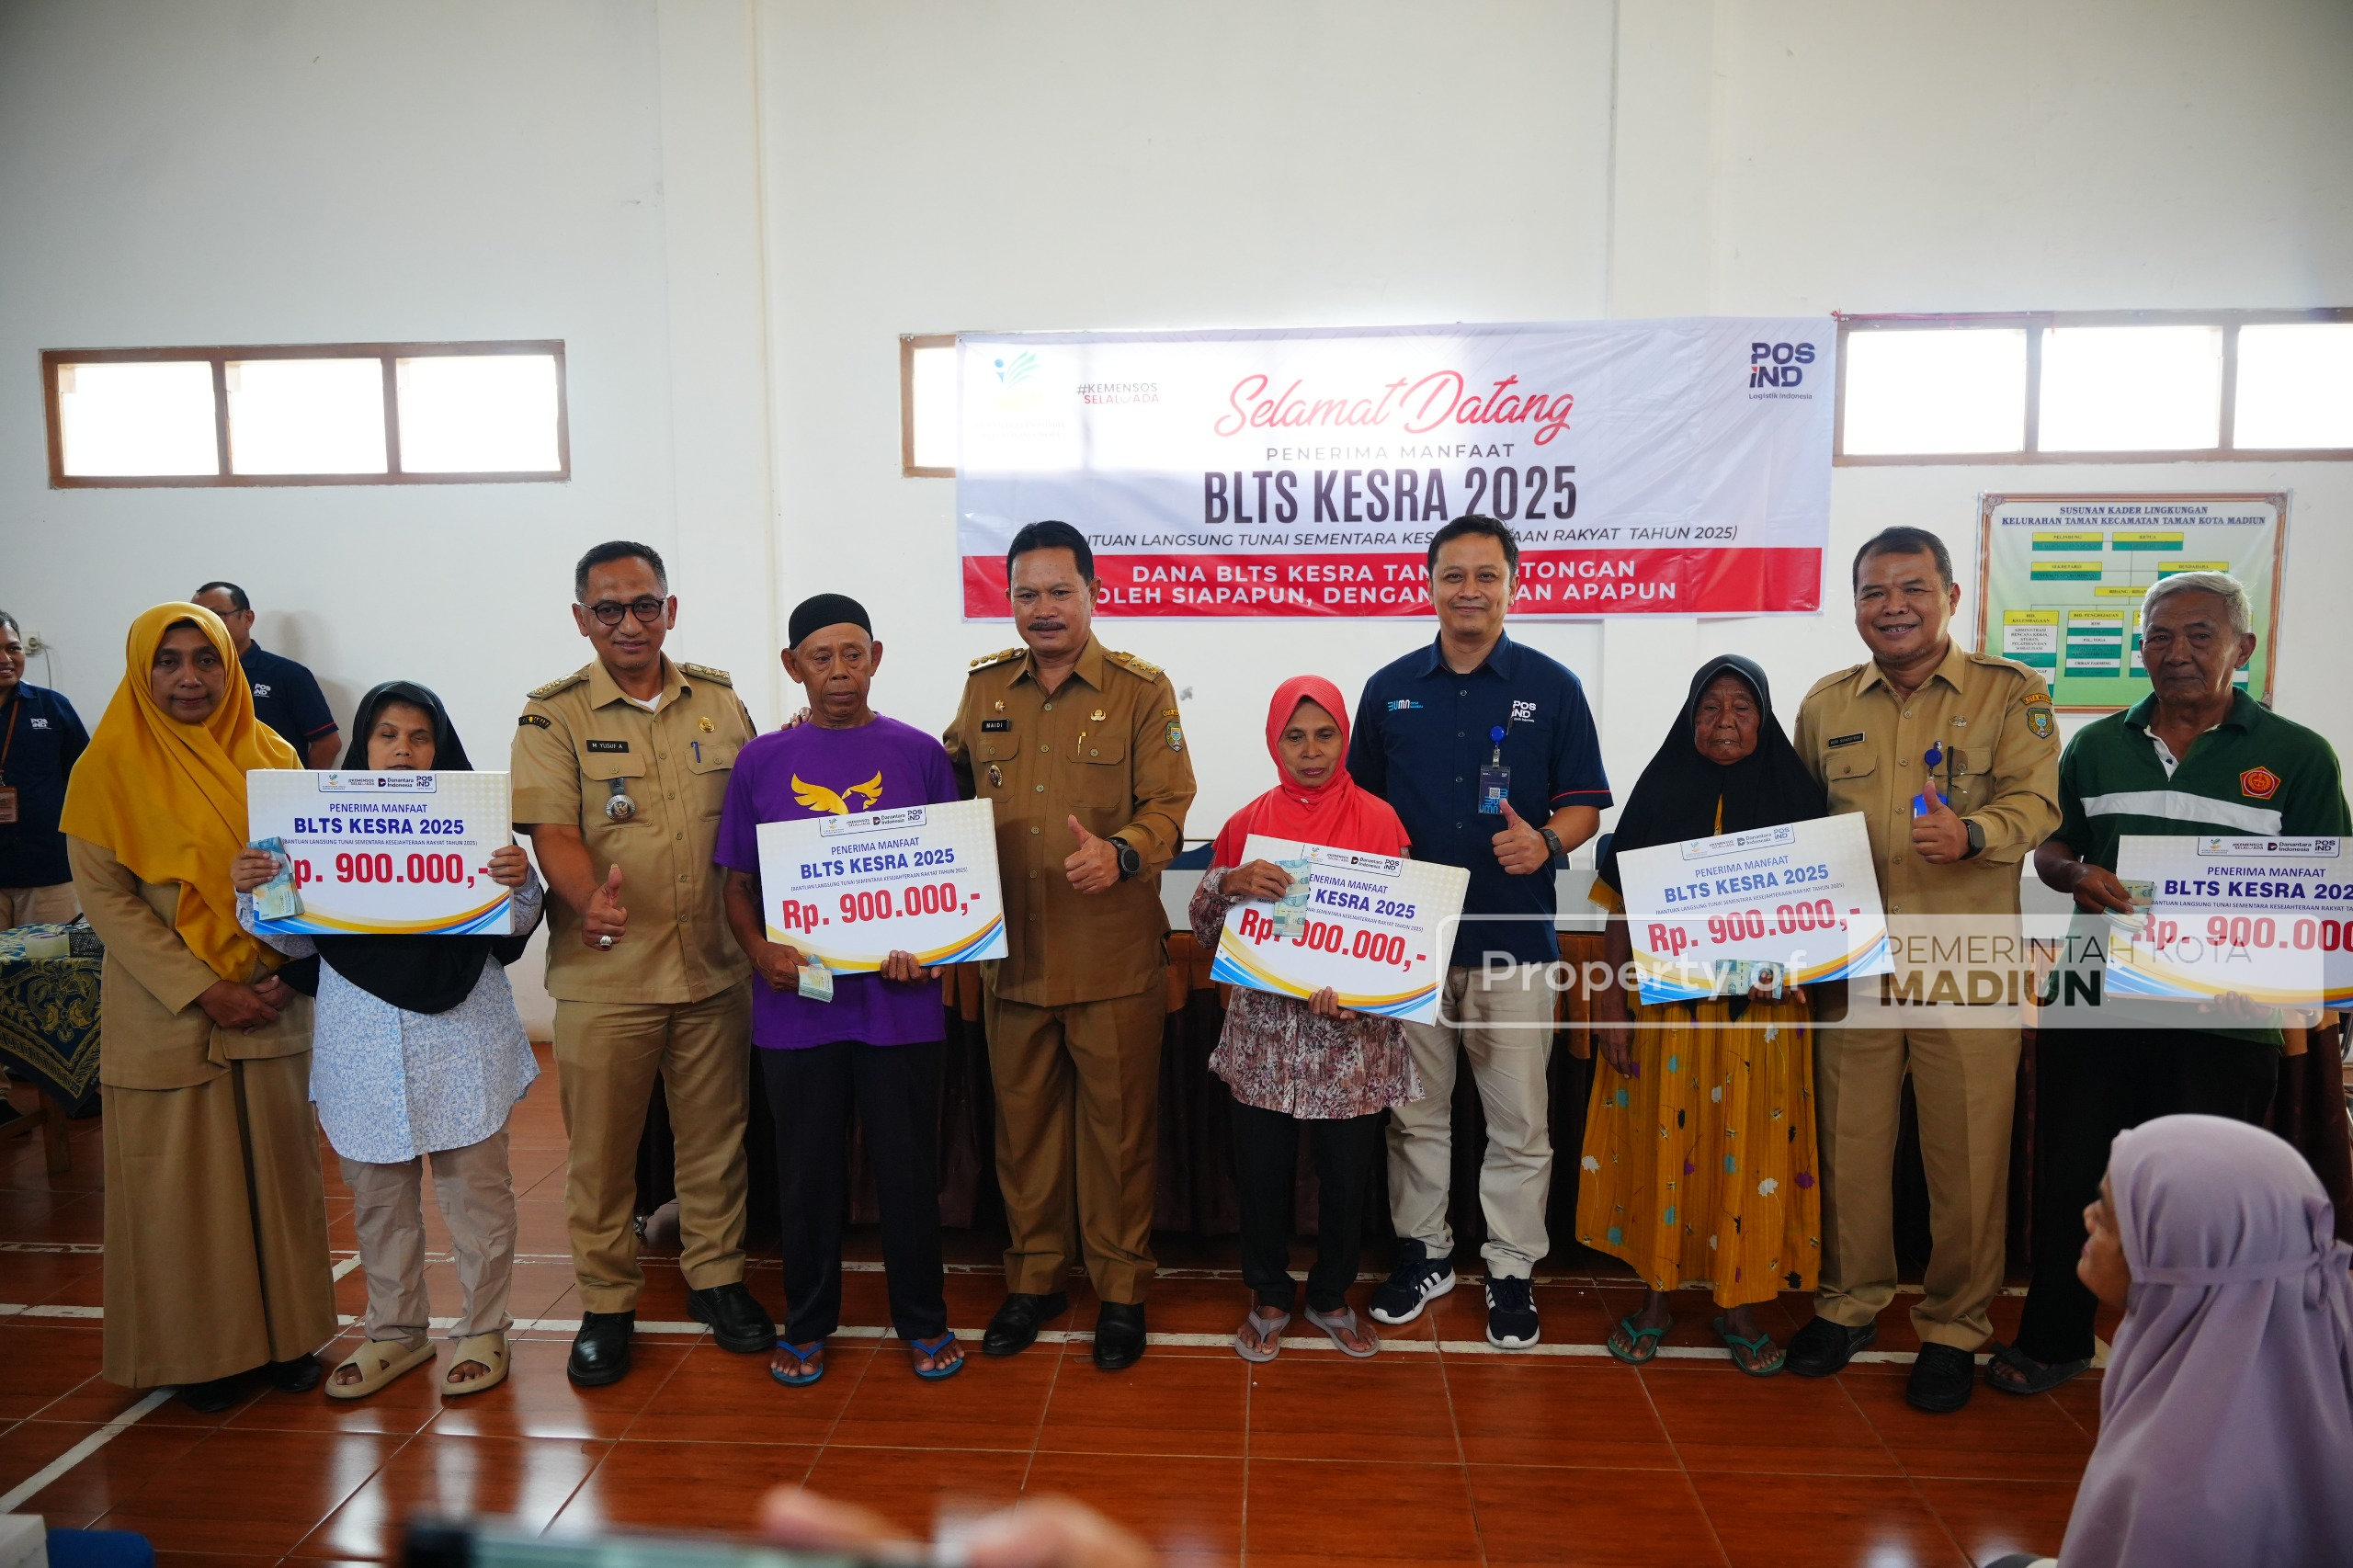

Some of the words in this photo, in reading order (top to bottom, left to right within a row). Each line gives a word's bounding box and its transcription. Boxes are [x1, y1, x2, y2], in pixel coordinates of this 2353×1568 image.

[1751, 343, 1815, 365] POS
[1076, 382, 1157, 395] #KEMENSOS
[1214, 374, 1406, 437] Selamat
[1399, 370, 1574, 446] Datang
[1267, 446, 1389, 460] PENERIMA
[1400, 444, 1515, 459] MANFAAT
[1204, 470, 1298, 524] BLTS
[1314, 468, 1449, 523] KESRA
[1464, 464, 1577, 521] 2025
[2002, 517, 2062, 525] KELURAHAN
[2064, 517, 2097, 525] TAMAN
[2101, 517, 2160, 525] KECAMATAN
[2163, 517, 2197, 525] TAMAN
[2199, 517, 2224, 525] KOTA
[2227, 517, 2266, 525] MADIUN
[2060, 506, 2105, 515] SUSUNAN
[2108, 506, 2142, 515] KADER
[2144, 506, 2208, 515] LINGKUNGAN
[1087, 535, 1136, 546] TUAN
[1141, 534, 1233, 546] LANGSUNG
[1238, 533, 1288, 546] TUNAI
[1293, 532, 1396, 545] SEMENTARA
[1553, 528, 1620, 542] RAKYAT
[1630, 527, 1688, 540] TAHUN
[1695, 524, 1738, 541] 2025)
[1132, 565, 1206, 583] DANA
[1216, 565, 1278, 582] BLTS
[1289, 564, 1374, 582] KESRA
[1383, 563, 1430, 581] TAN
[1516, 561, 1636, 579] TONGAN
[1097, 587, 1162, 605] OLEH
[1172, 586, 1313, 607] SIAPAPUN,
[1563, 582, 1677, 600] APAPUN
[1512, 700, 1536, 710] POS
[329, 803, 380, 812] PENERIMA
[381, 804, 427, 812] MANFAAT
[294, 817, 343, 834] BLTS
[350, 818, 414, 835] KESRA
[419, 819, 464, 835] 2025
[831, 842, 876, 856] PENERIMA
[878, 837, 920, 850] MANFAAT
[286, 854, 323, 889] p.
[335, 853, 489, 889] 900.000,-
[801, 860, 845, 880] BLTS
[849, 853, 909, 874] KESRA
[914, 847, 955, 867] 2025
[1695, 863, 1742, 879] PENERIMA
[1745, 855, 1790, 870] MANFAAT
[2207, 866, 2266, 877] PENERIMA
[2269, 868, 2326, 878] MANFAAT
[1309, 873, 1346, 888] ENERIMA
[1347, 878, 1389, 894] MANFAAT
[1665, 882, 1711, 903] BLTS
[1715, 871, 1779, 896] KESRA
[1784, 864, 1829, 884] 2025
[2165, 880, 2221, 896] BLTS
[2228, 881, 2306, 899] KESRA
[2313, 883, 2353, 900] 202
[782, 899, 830, 934] Rp.
[839, 882, 981, 924] 900.000,-
[1315, 888, 1370, 912] KESRA
[1375, 900, 1416, 919] 2025
[1647, 922, 1699, 957] Rp.
[1708, 899, 1860, 944] 900.000,-
